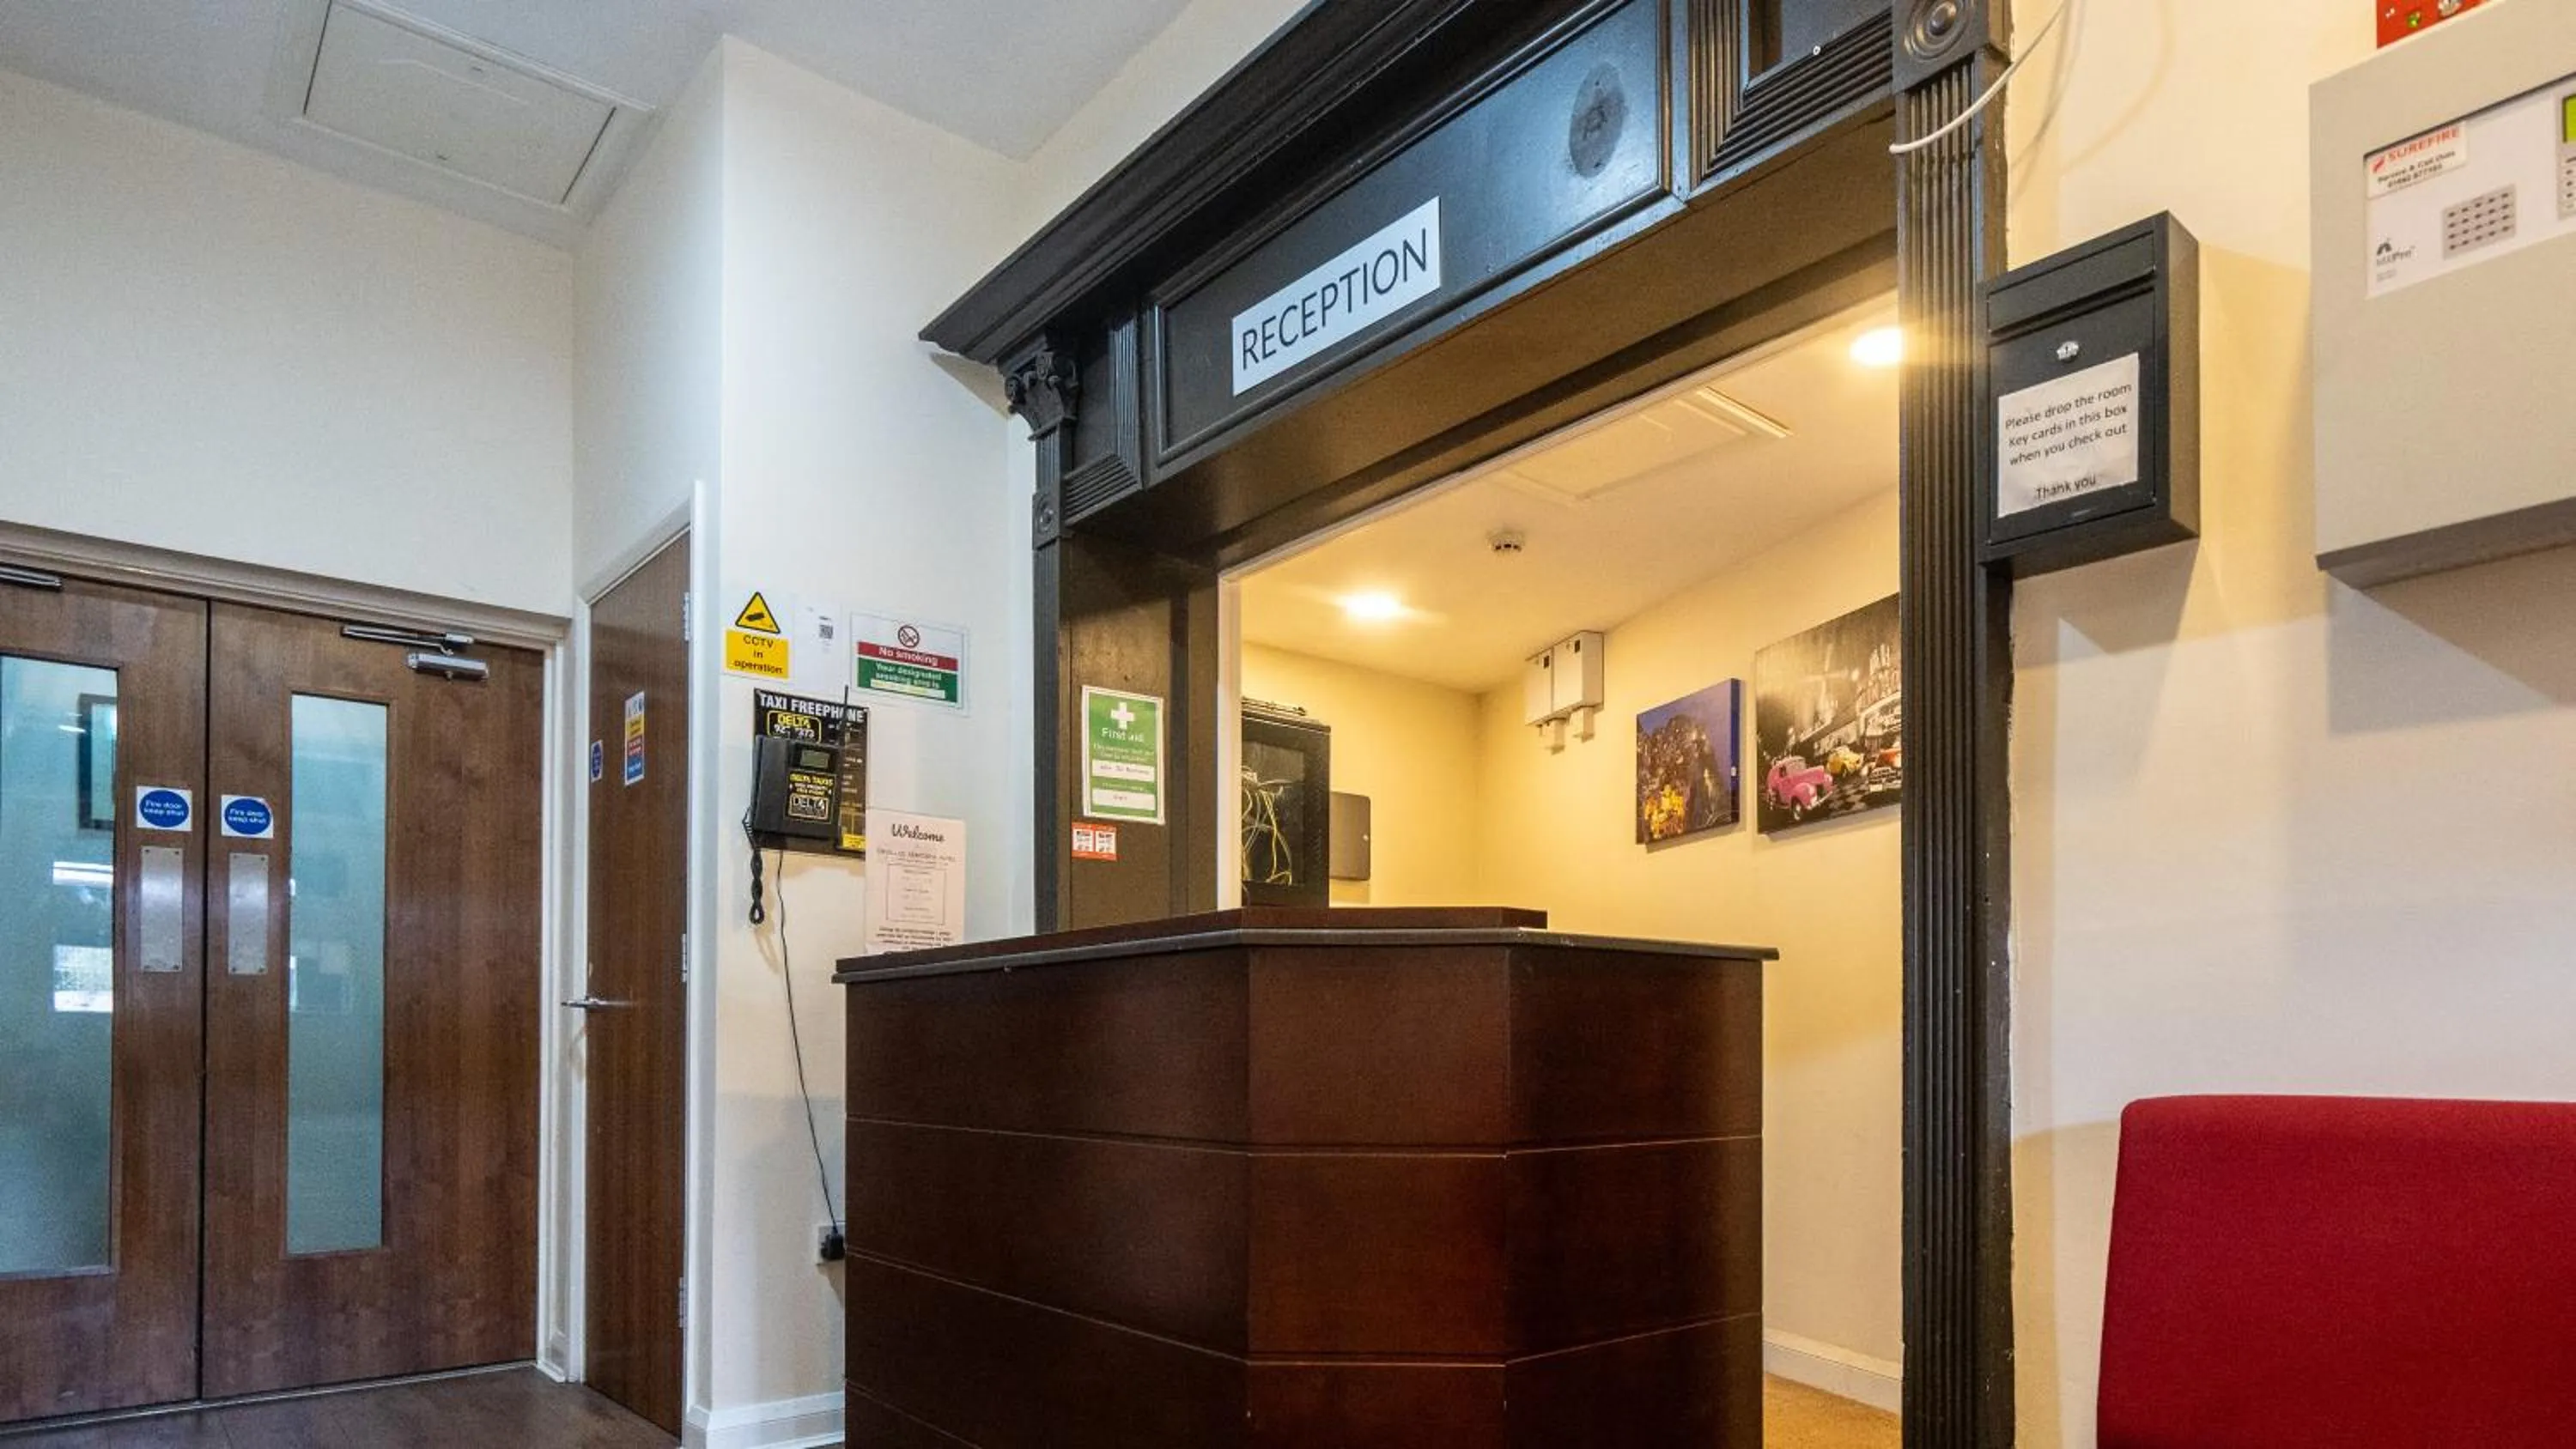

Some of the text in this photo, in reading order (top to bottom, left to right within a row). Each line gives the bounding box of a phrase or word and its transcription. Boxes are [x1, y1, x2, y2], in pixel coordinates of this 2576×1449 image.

[2389, 127, 2459, 161] SUREFIRE
[1242, 227, 1427, 370] RECEPTION
[2005, 384, 2132, 430] Please drop the room
[2008, 404, 2128, 448] Key cards in this box
[2009, 423, 2128, 466] when you check out
[2035, 474, 2097, 500] Thank you
[743, 634, 774, 648] CCTV
[753, 650, 763, 658] in
[878, 646, 939, 666] No smoking
[734, 660, 783, 674] operation
[759, 693, 865, 724] TAXI FREEPHNE
[777, 713, 811, 729] DELTA
[1102, 727, 1145, 743] First aid
[143, 807, 185, 816] keep shut
[145, 799, 183, 809] Fire door
[793, 796, 825, 810] DELTA
[228, 808, 246, 816] Fire
[891, 823, 945, 842] Welcome
